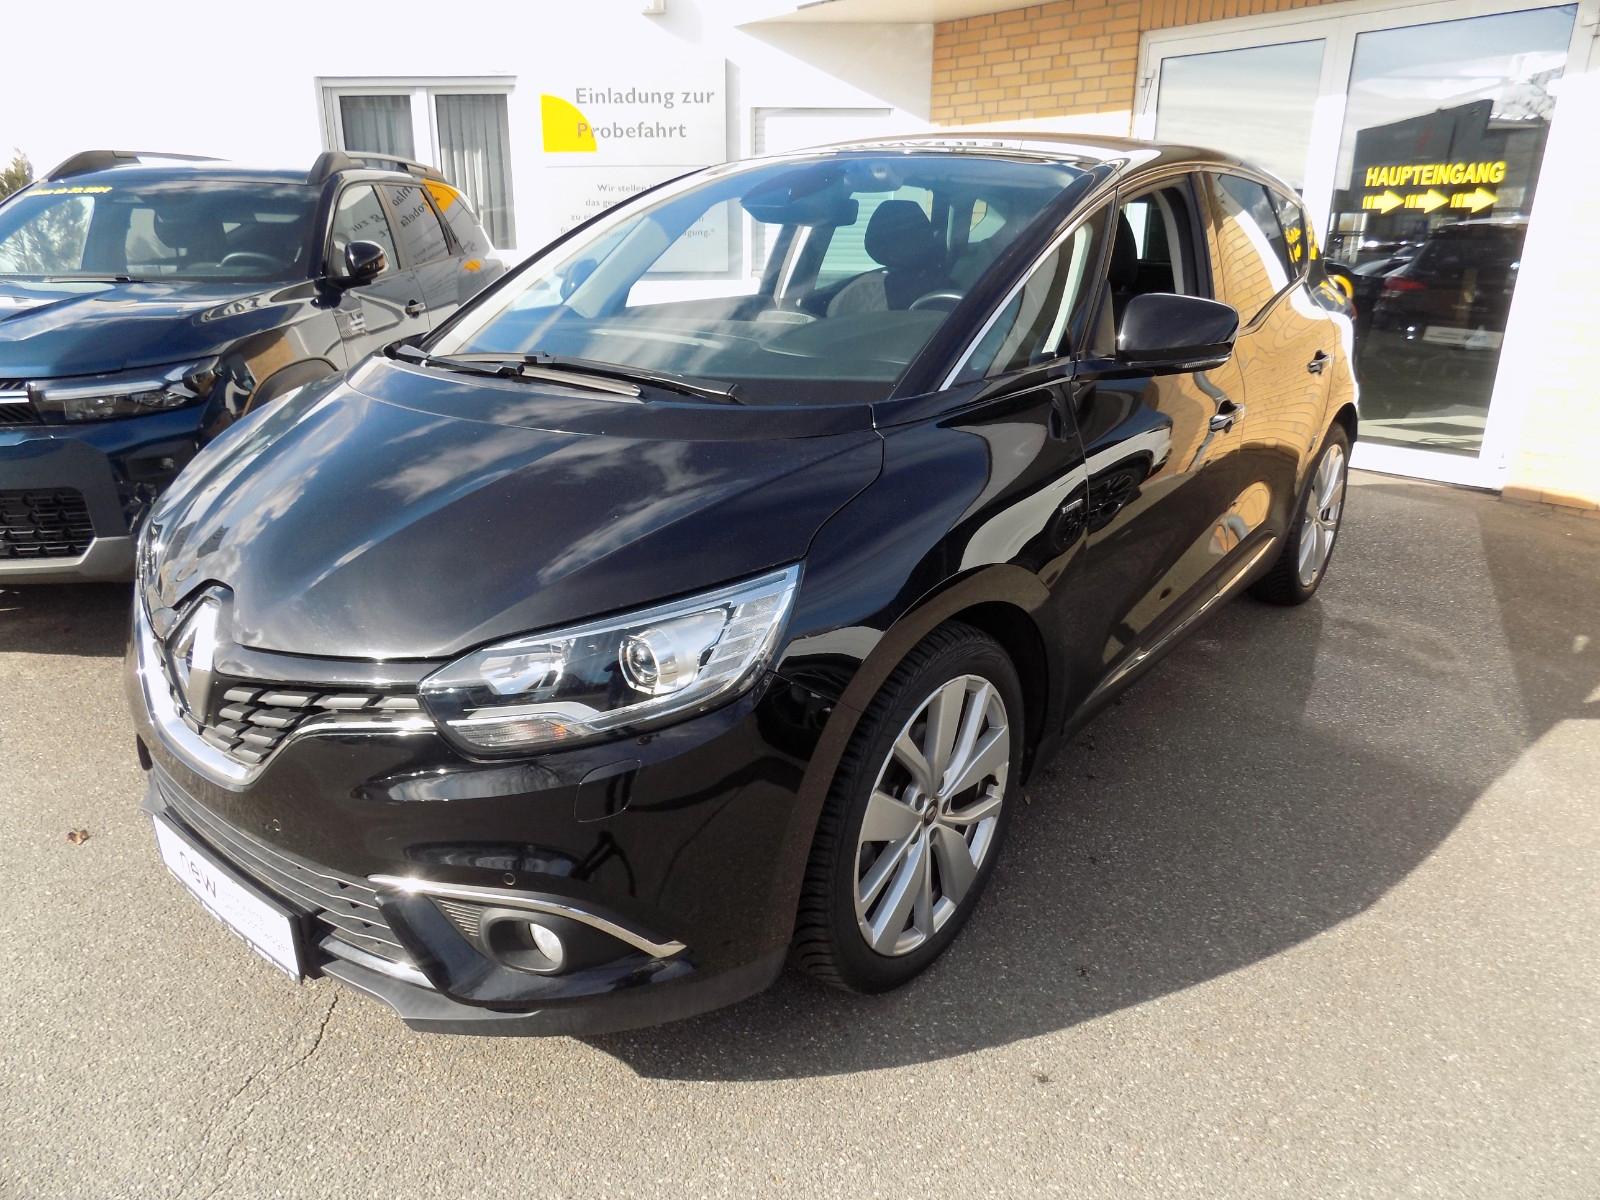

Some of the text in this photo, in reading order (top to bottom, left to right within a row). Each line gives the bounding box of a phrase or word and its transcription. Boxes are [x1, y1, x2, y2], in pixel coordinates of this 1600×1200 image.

[575, 87, 715, 108] Einladung zur
[577, 121, 687, 138] Probefahrt
[1364, 161, 1506, 187] HAUPTEINGANG
[597, 184, 614, 192] Wir
